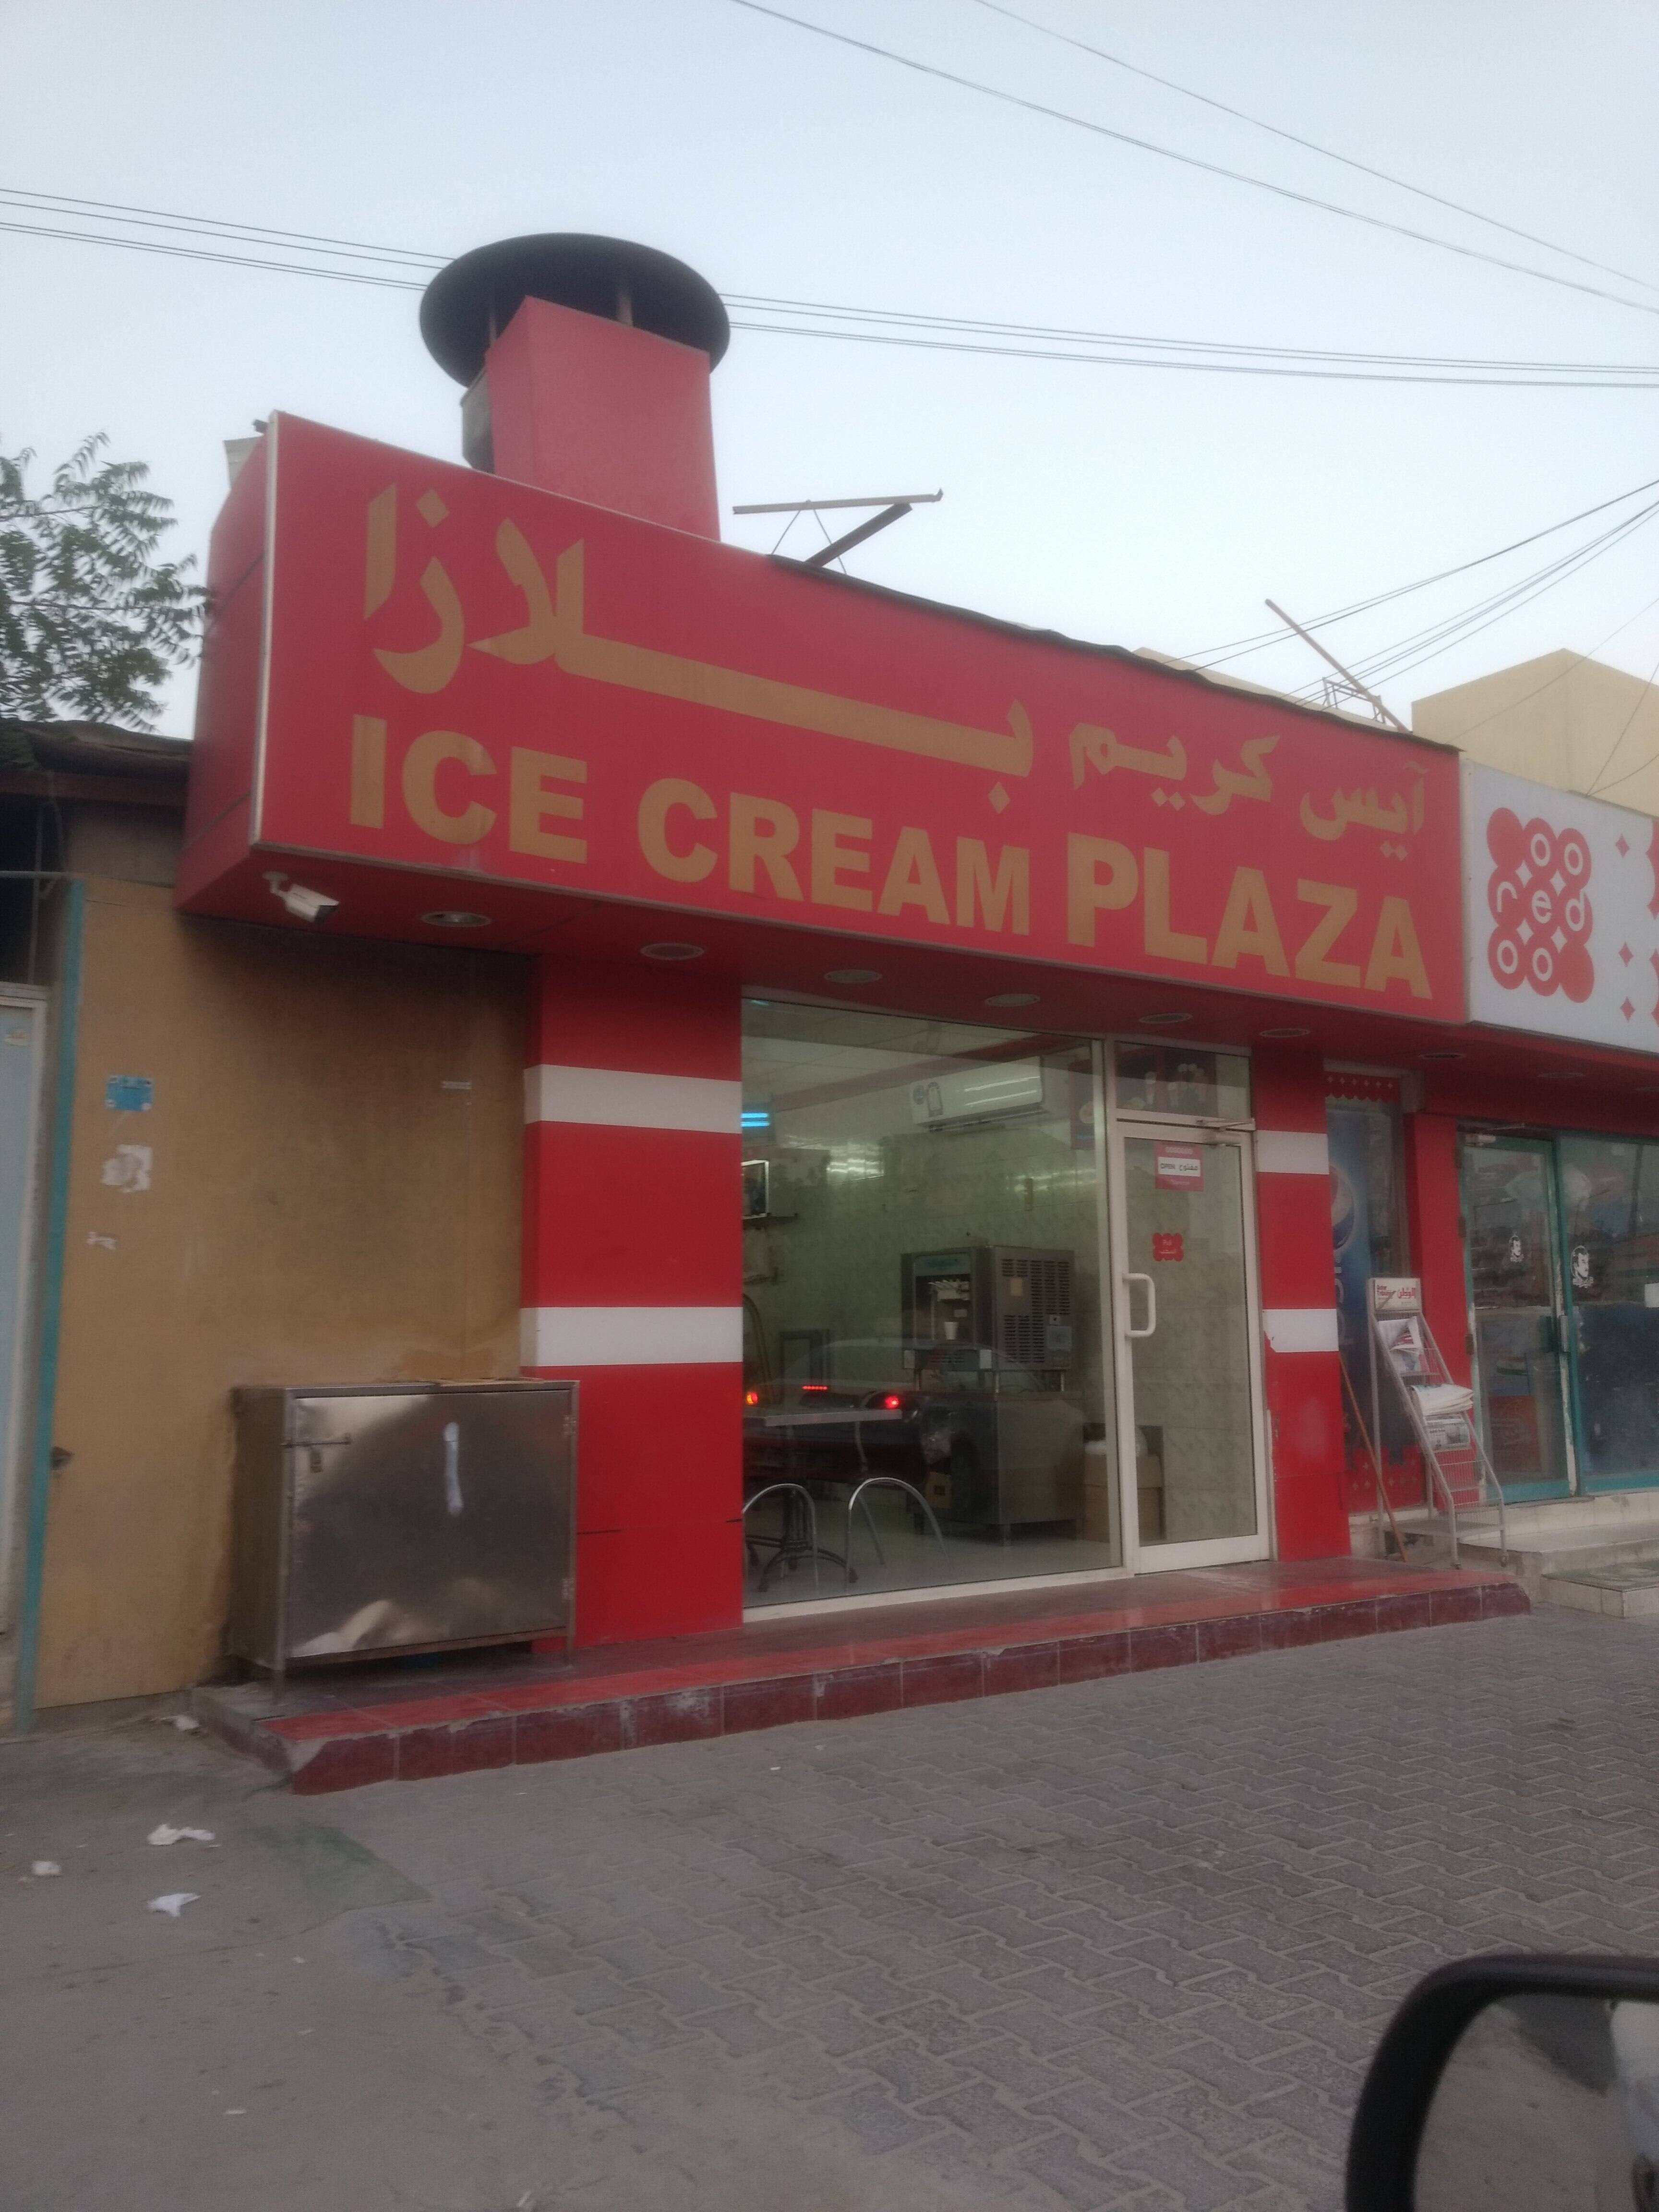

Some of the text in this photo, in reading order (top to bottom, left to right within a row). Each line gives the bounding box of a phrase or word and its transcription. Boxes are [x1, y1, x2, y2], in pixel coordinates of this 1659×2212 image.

[364, 481, 1034, 815] بلازا
[1069, 722, 1281, 816] كريم
[349, 714, 1433, 1000] ICE CREAM PLAZA
